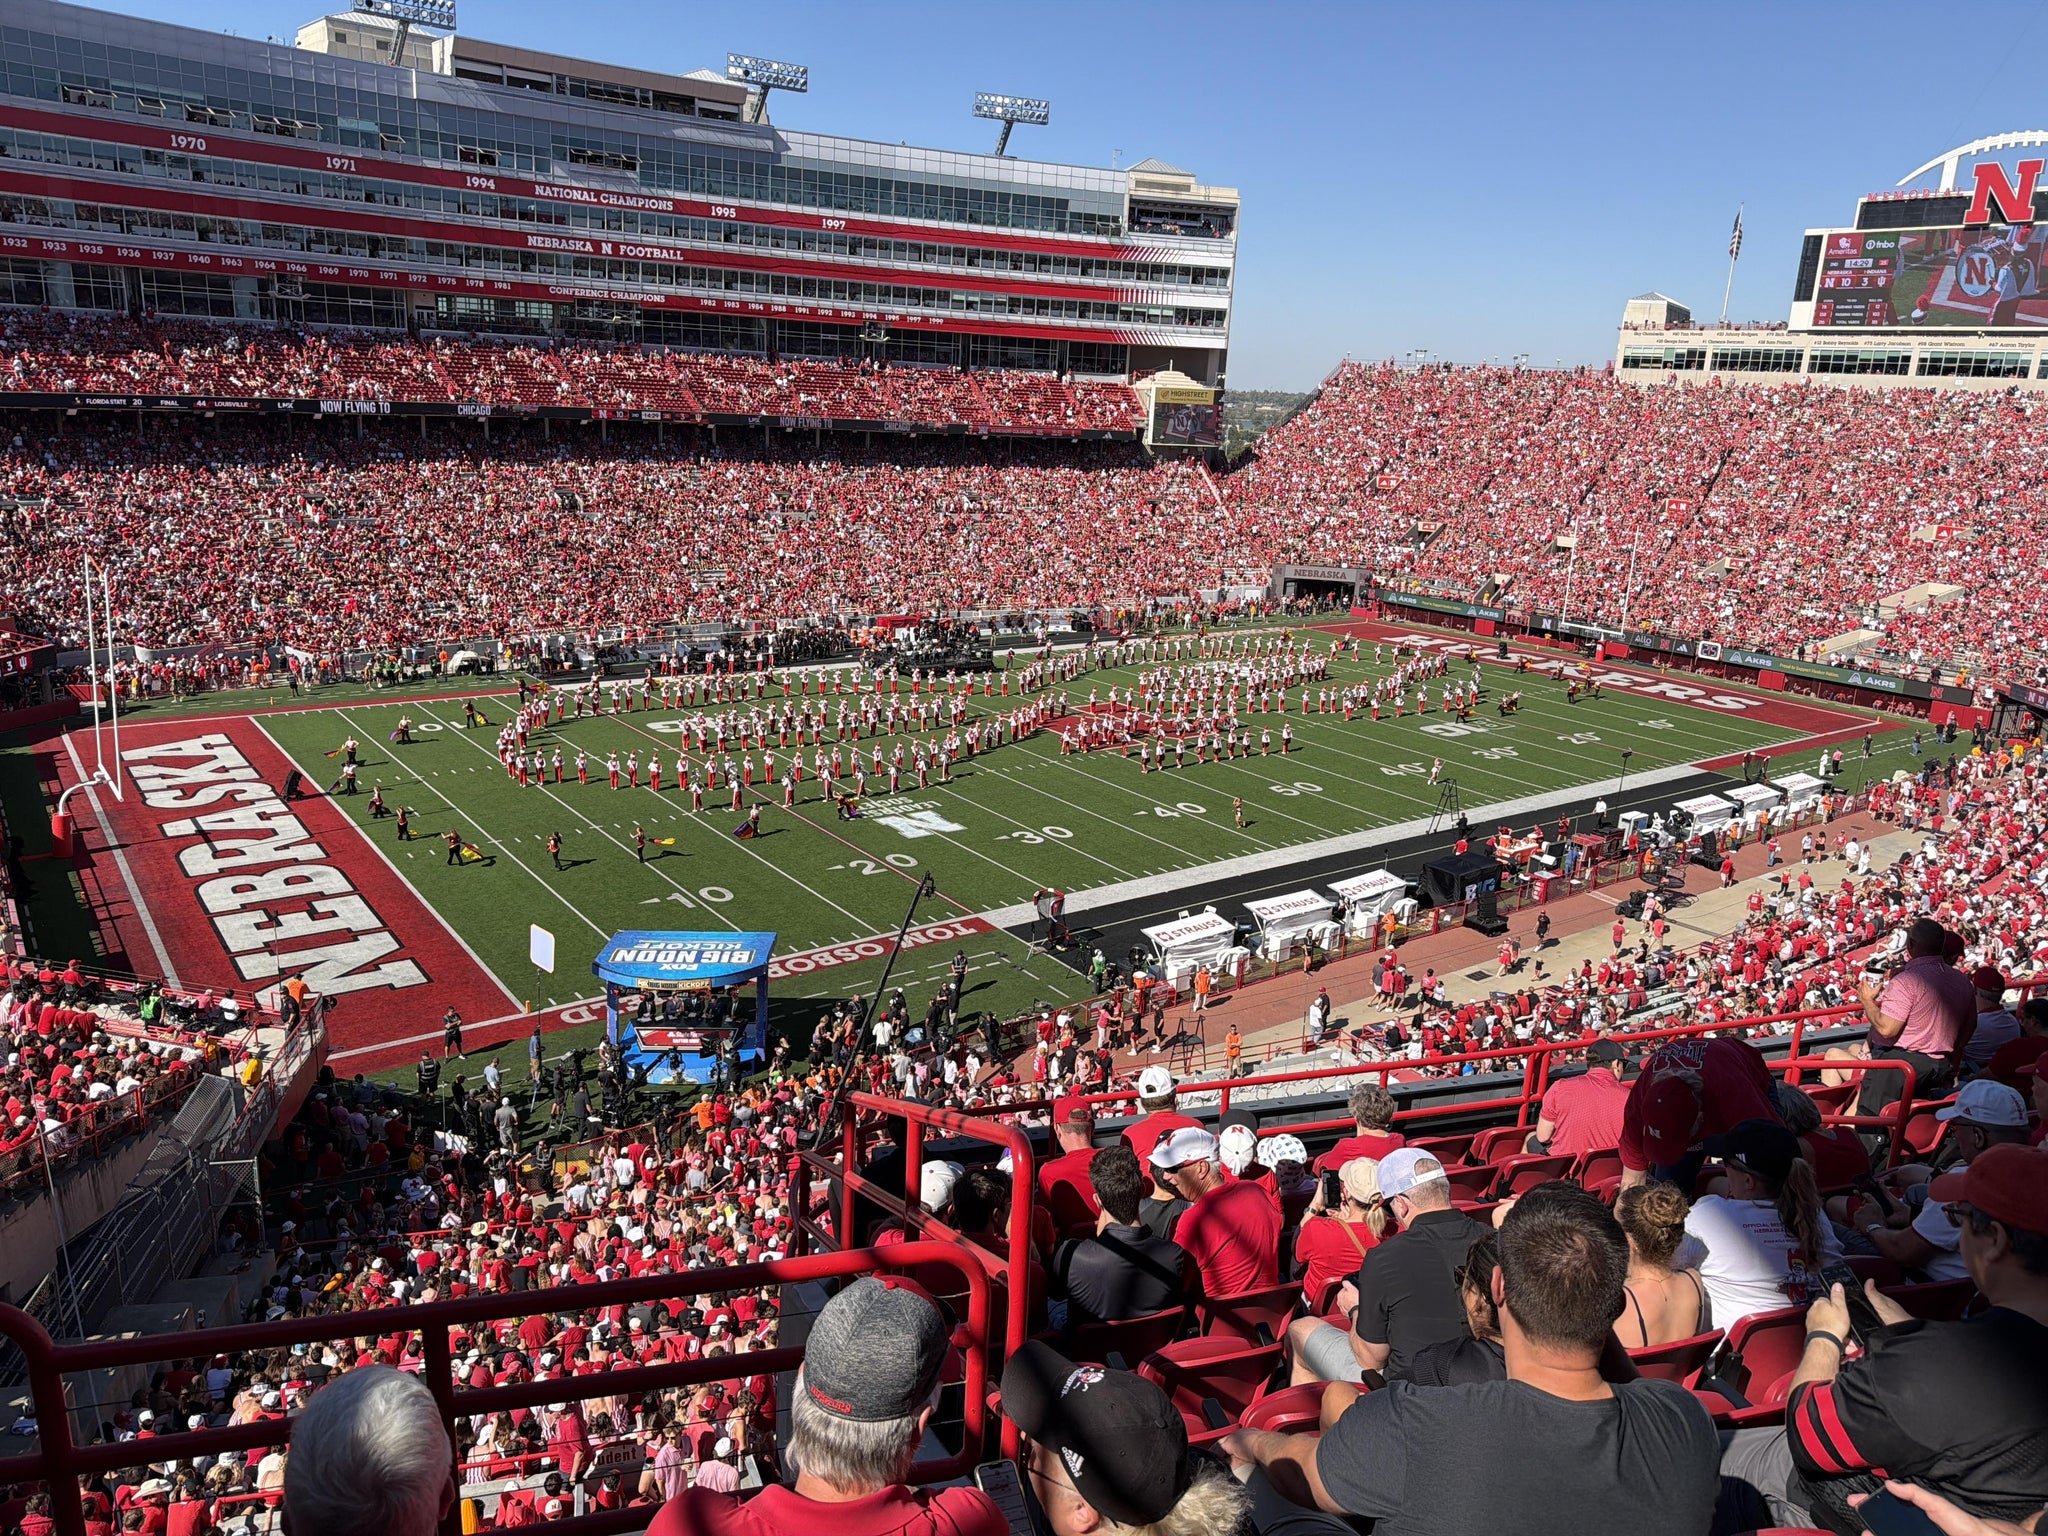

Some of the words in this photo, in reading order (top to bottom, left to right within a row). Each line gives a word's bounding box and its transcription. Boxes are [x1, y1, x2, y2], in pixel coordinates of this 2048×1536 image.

[170, 134, 207, 152] 1970
[325, 155, 357, 173] 1971
[466, 175, 496, 190] 1994
[534, 184, 598, 204] NATIONAL
[599, 193, 674, 212] CHAMPIONS
[1867, 187, 1964, 202] MEMORIAL
[1963, 158, 2045, 225] N
[710, 204, 737, 219] 1995
[821, 217, 847, 231] 1997
[527, 235, 594, 254] NEBRASKA
[601, 241, 613, 256] N
[618, 244, 684, 261] FOOTBALL
[1876, 240, 1895, 248] fnbo
[3, 237, 28, 248] 1932
[42, 241, 67, 252] 1933
[79, 244, 103, 255] 1935
[117, 247, 141, 258] 1936
[152, 251, 175, 261] 1937
[188, 254, 210, 264] 1940
[221, 257, 243, 267] 1963
[254, 260, 276, 270] 1964
[286, 263, 307, 273] 1966
[319, 266, 339, 275] 1969
[349, 269, 369, 278] 1970
[379, 271, 398, 281] 1971
[408, 273, 428, 283] 1972
[438, 276, 457, 286] 1975
[466, 279, 484, 288] 1978
[494, 281, 512, 290] 1981
[1965, 257, 1988, 285] N
[1824, 278, 1835, 288] N
[1841, 278, 1851, 286] 10
[1861, 277, 1869, 286] 3
[548, 286, 609, 299] CONFERENCE
[610, 290, 666, 303] CHAMPIONS
[700, 298, 716, 307] 1982
[724, 300, 740, 309] 1983
[748, 302, 764, 311] 1984
[794, 306, 810, 315] 1991
[817, 308, 833, 317] 1992
[840, 310, 856, 319] 1993
[906, 315, 922, 323] 1997
[320, 400, 342, 413] NOW
[345, 401, 376, 414] FLYING
[378, 402, 391, 414] TO
[457, 405, 492, 416] CHICAGO
[615, 410, 624, 418] 10
[598, 410, 607, 419] N
[779, 417, 797, 427] NOW
[798, 418, 822, 428] FLYING
[823, 419, 832, 429] TO
[884, 422, 911, 431] CHICAGO
[1275, 567, 1283, 575] N
[1294, 568, 1347, 579] NEBRASKA
[1398, 596, 1417, 604] AKRS
[1478, 609, 1499, 618] AKRS
[1542, 618, 1551, 629] N
[1634, 634, 1652, 644] Allo
[1660, 639, 1670, 650] N
[1701, 644, 1717, 656] 25
[6, 660, 13, 671] 3
[1744, 655, 1772, 667] AKRS
[1797, 665, 1811, 673] Support
[1865, 676, 1896, 688] AKRS
[1930, 686, 1944, 699] N
[2028, 692, 2035, 702] N
[2038, 695, 2044, 704] 10
[1557, 731, 1602, 745] 20
[1472, 745, 1519, 760] 30
[1380, 762, 1426, 777] 40
[1268, 781, 1323, 797] 50
[1154, 802, 1207, 818] 40
[1693, 796, 1724, 812] STRAUSS
[872, 810, 968, 839] N
[1011, 825, 1074, 844] 30
[120, 733, 431, 1008] NEBRASKA
[848, 853, 919, 876] 20
[1352, 876, 1395, 894] STRAUSS
[665, 886, 735, 909] 10
[1273, 896, 1321, 916] STRAUSS
[1173, 917, 1223, 938] STRAUSS
[889, 922, 978, 949] TOM
[634, 940, 743, 950] KICKOFF
[614, 950, 698, 963] NOON
[699, 950, 752, 963] BIG
[660, 963, 698, 971] FOX
[638, 980, 648, 988] FOX
[678, 980, 710, 989] KICKOFF
[1231, 1126, 1245, 1134] N
[1061, 1446, 1082, 1478] adidas
